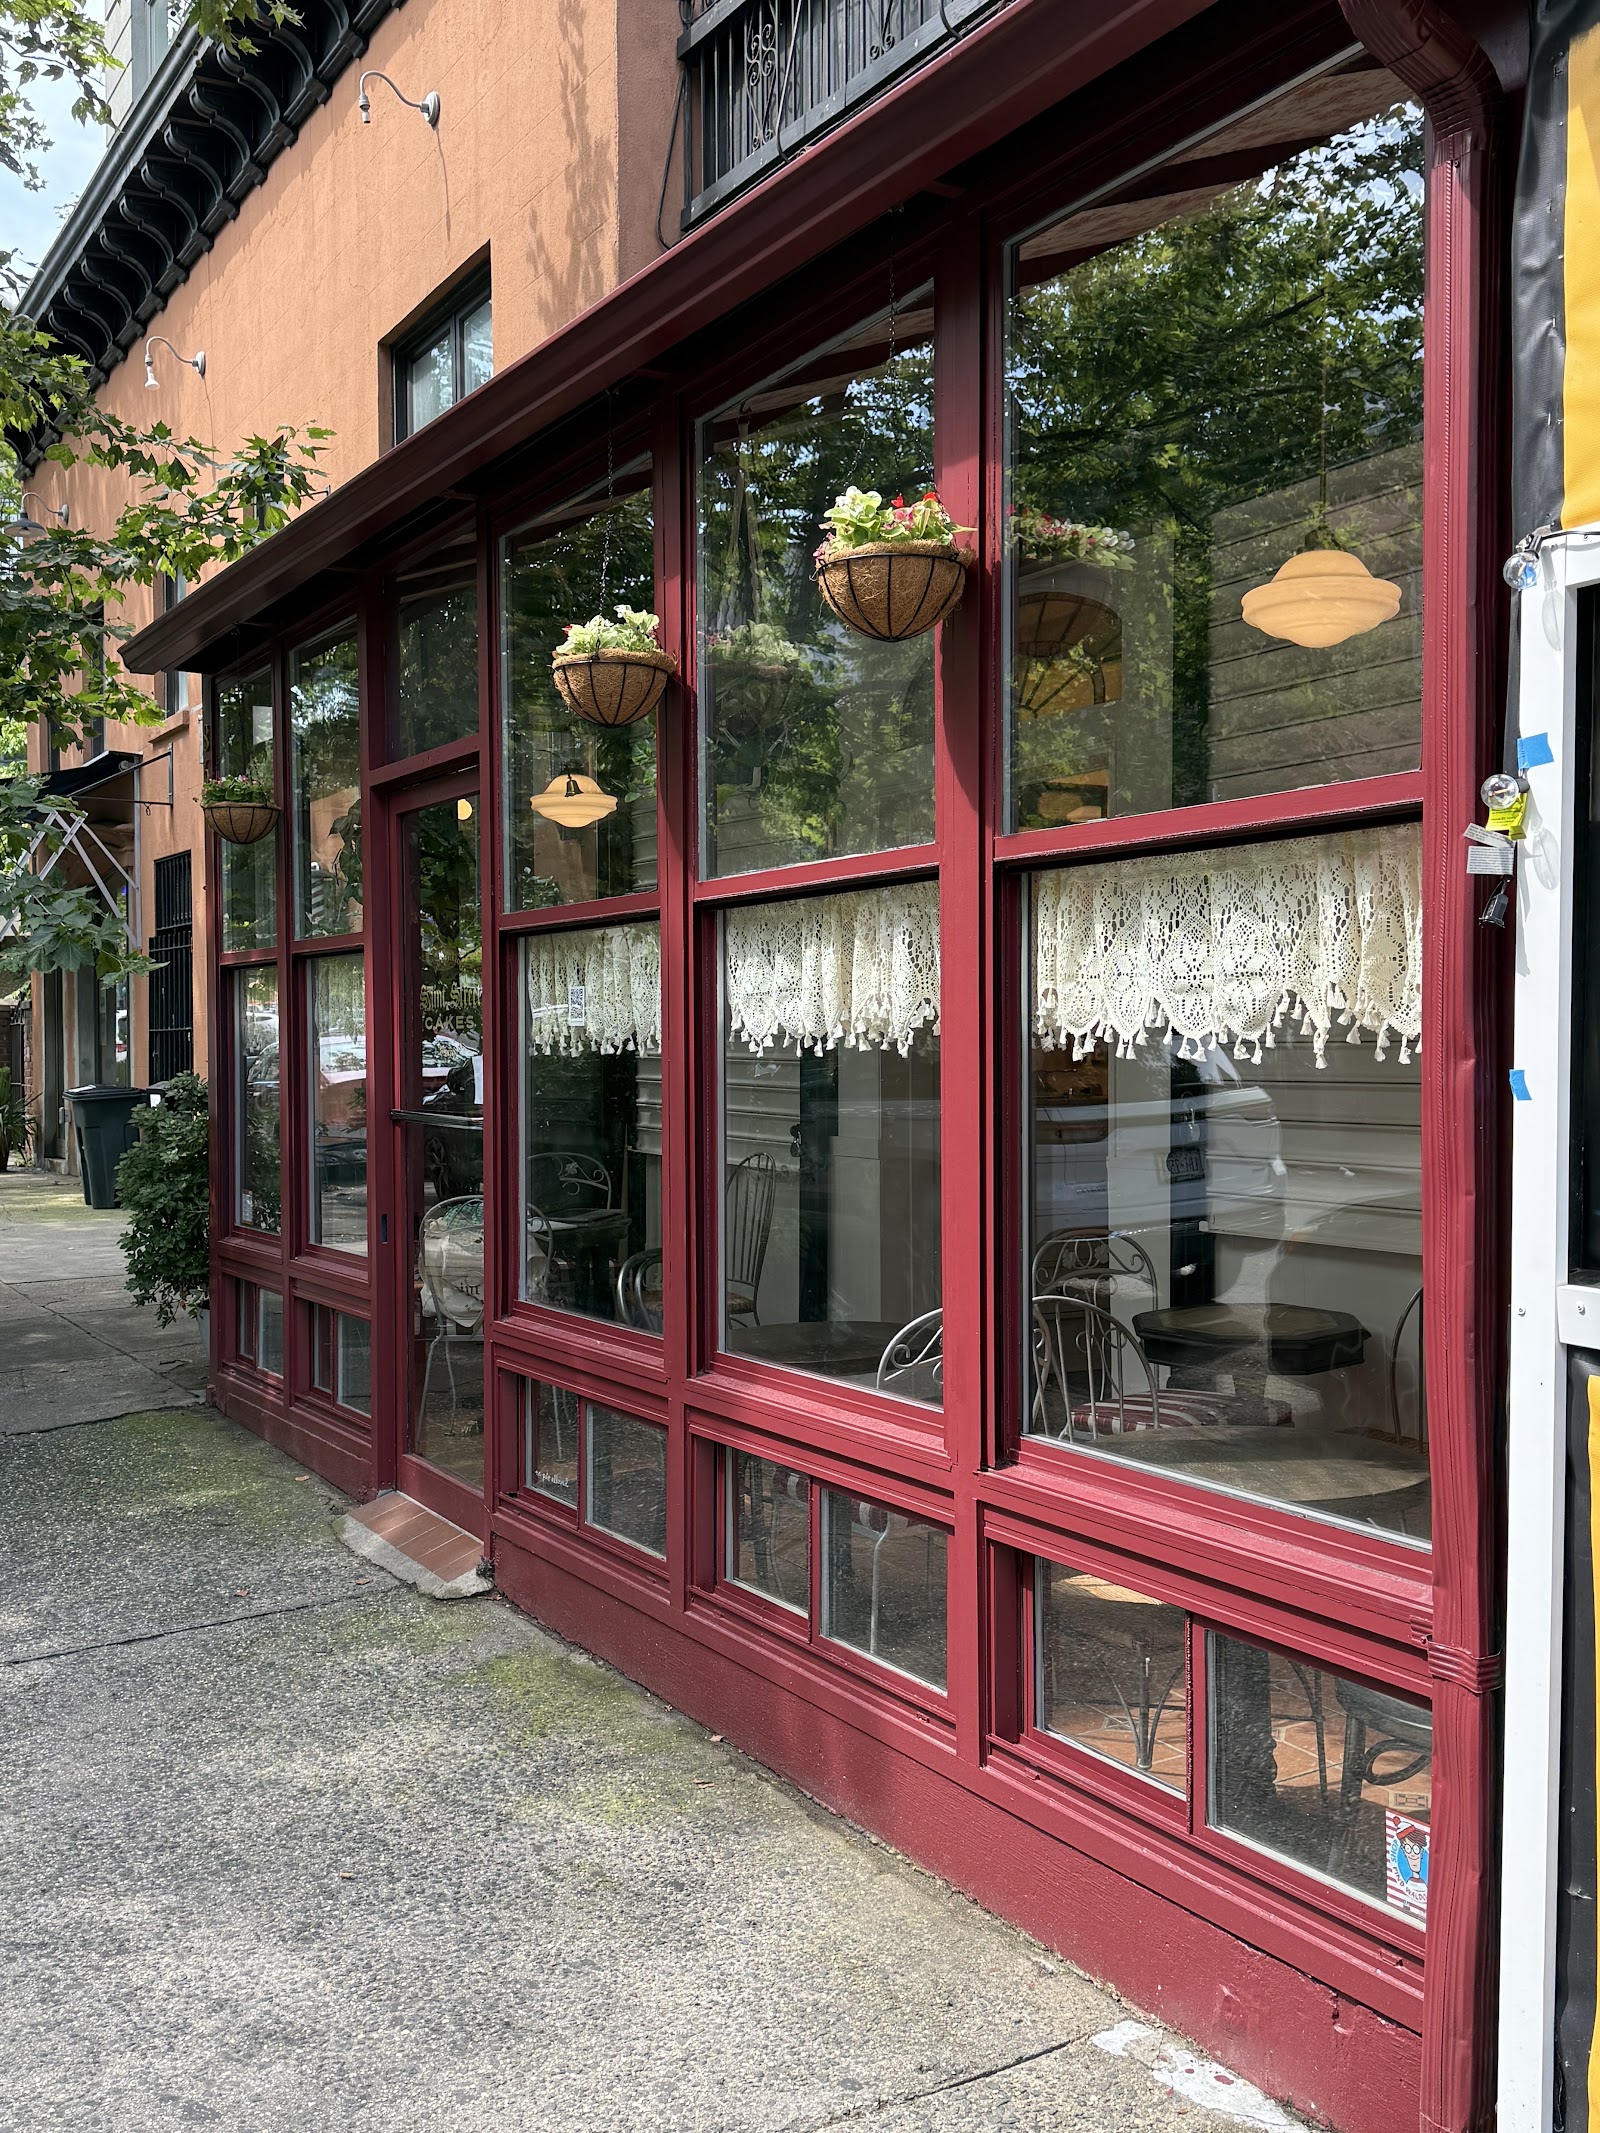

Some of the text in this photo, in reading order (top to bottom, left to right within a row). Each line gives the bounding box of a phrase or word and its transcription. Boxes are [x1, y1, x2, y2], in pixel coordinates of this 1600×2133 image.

[450, 981, 482, 1009] Street
[424, 1015, 475, 1030] CAKES
[1391, 1839, 1399, 1862] SHOP
[1393, 1866, 1405, 1887] FIND
